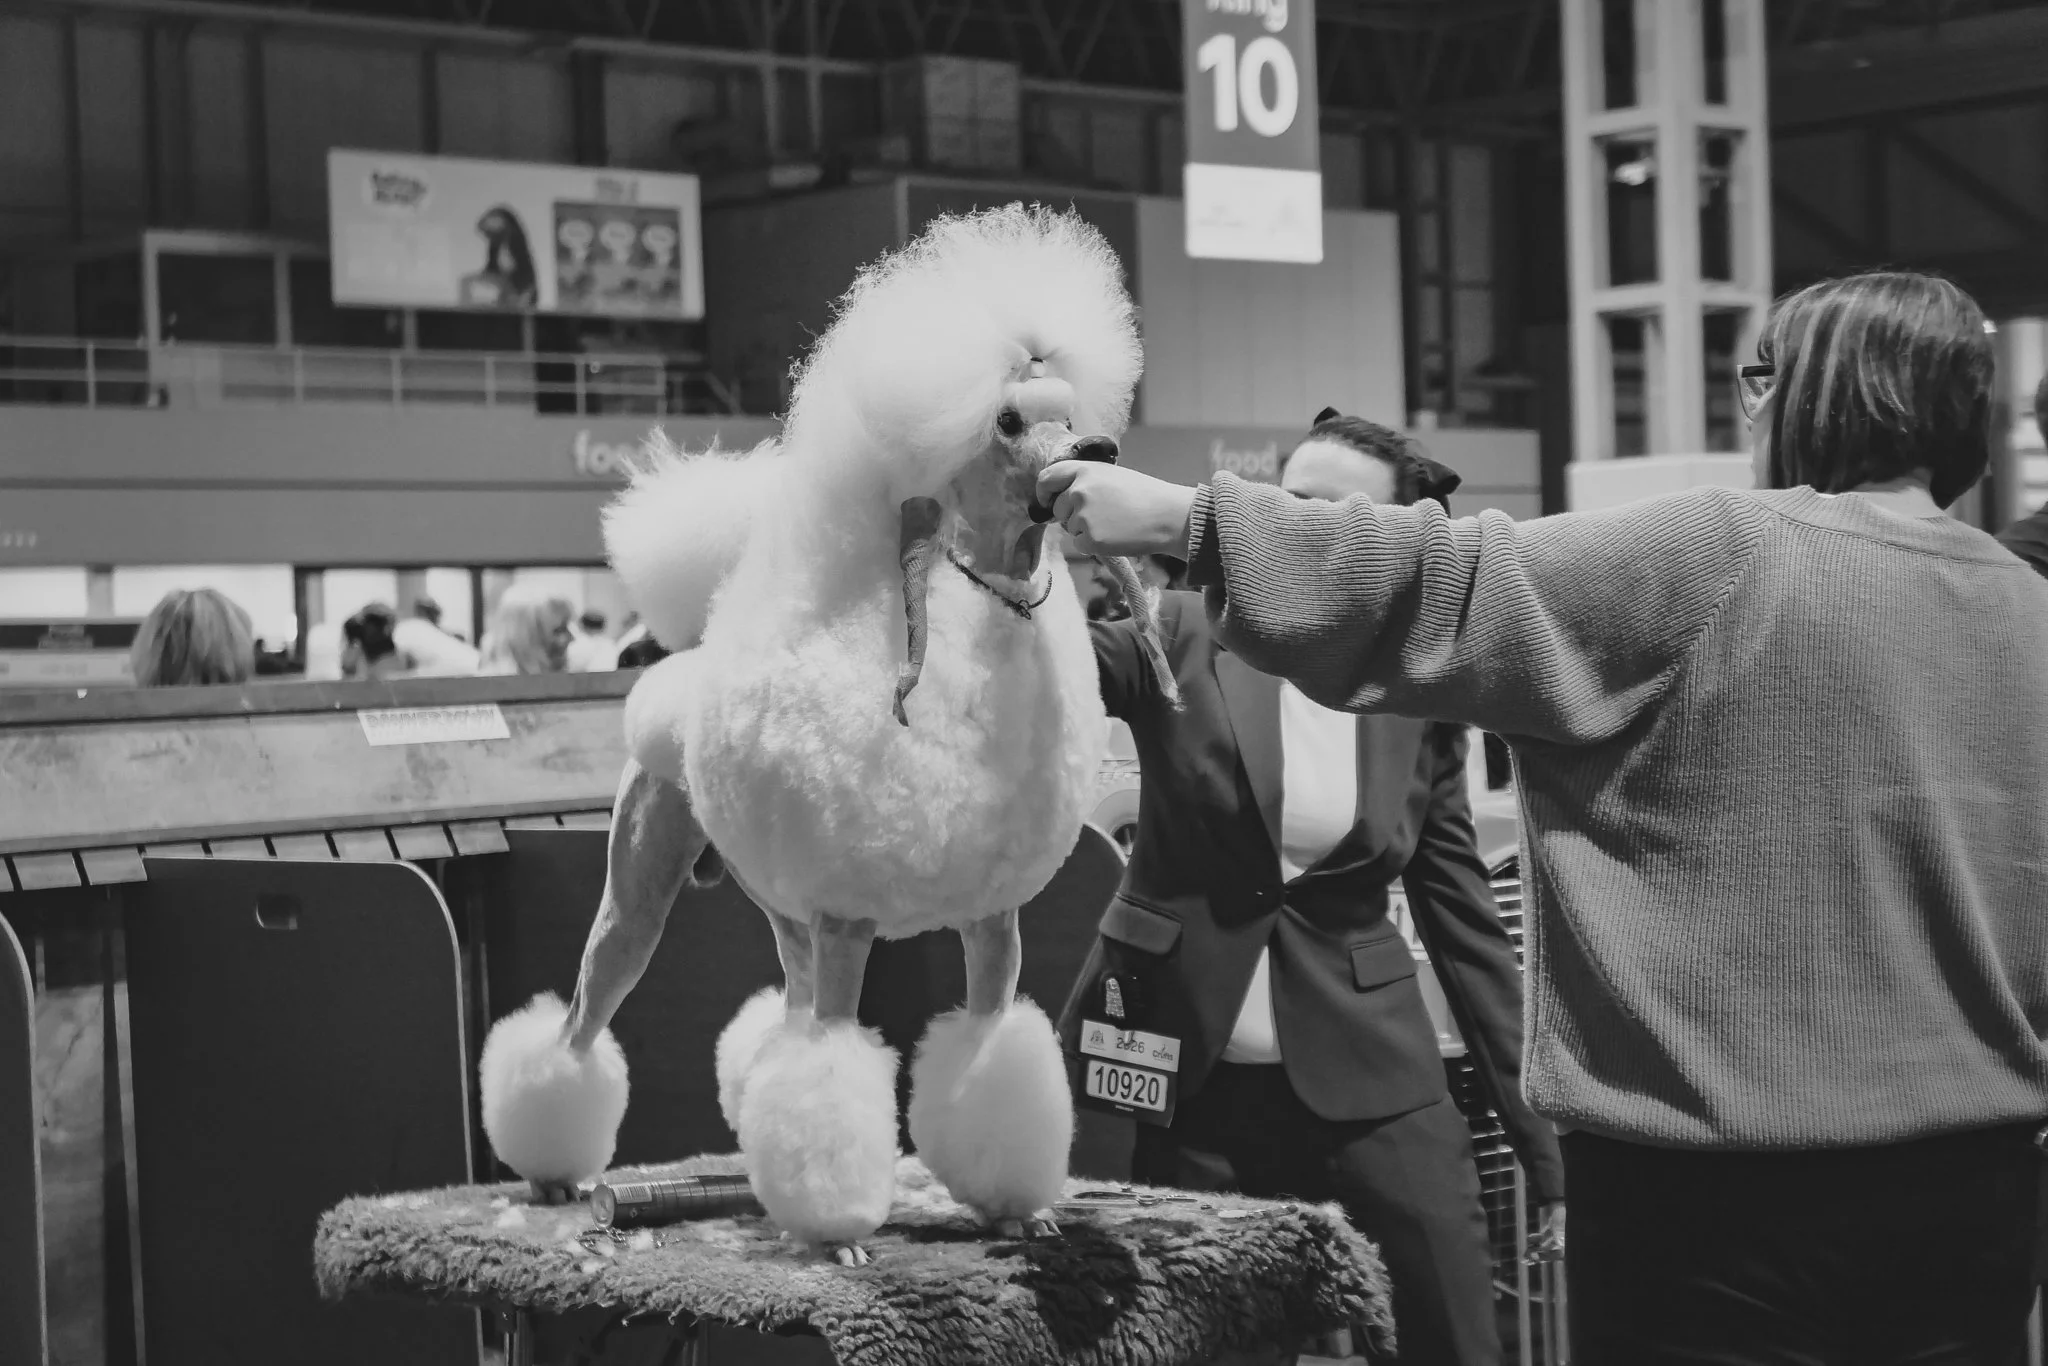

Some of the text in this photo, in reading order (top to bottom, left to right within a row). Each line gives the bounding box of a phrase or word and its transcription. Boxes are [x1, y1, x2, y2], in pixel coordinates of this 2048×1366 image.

[1197, 33, 1299, 138] 10
[574, 428, 650, 476] foo
[1209, 437, 1278, 476] food
[1096, 1066, 1160, 1105] 10920
